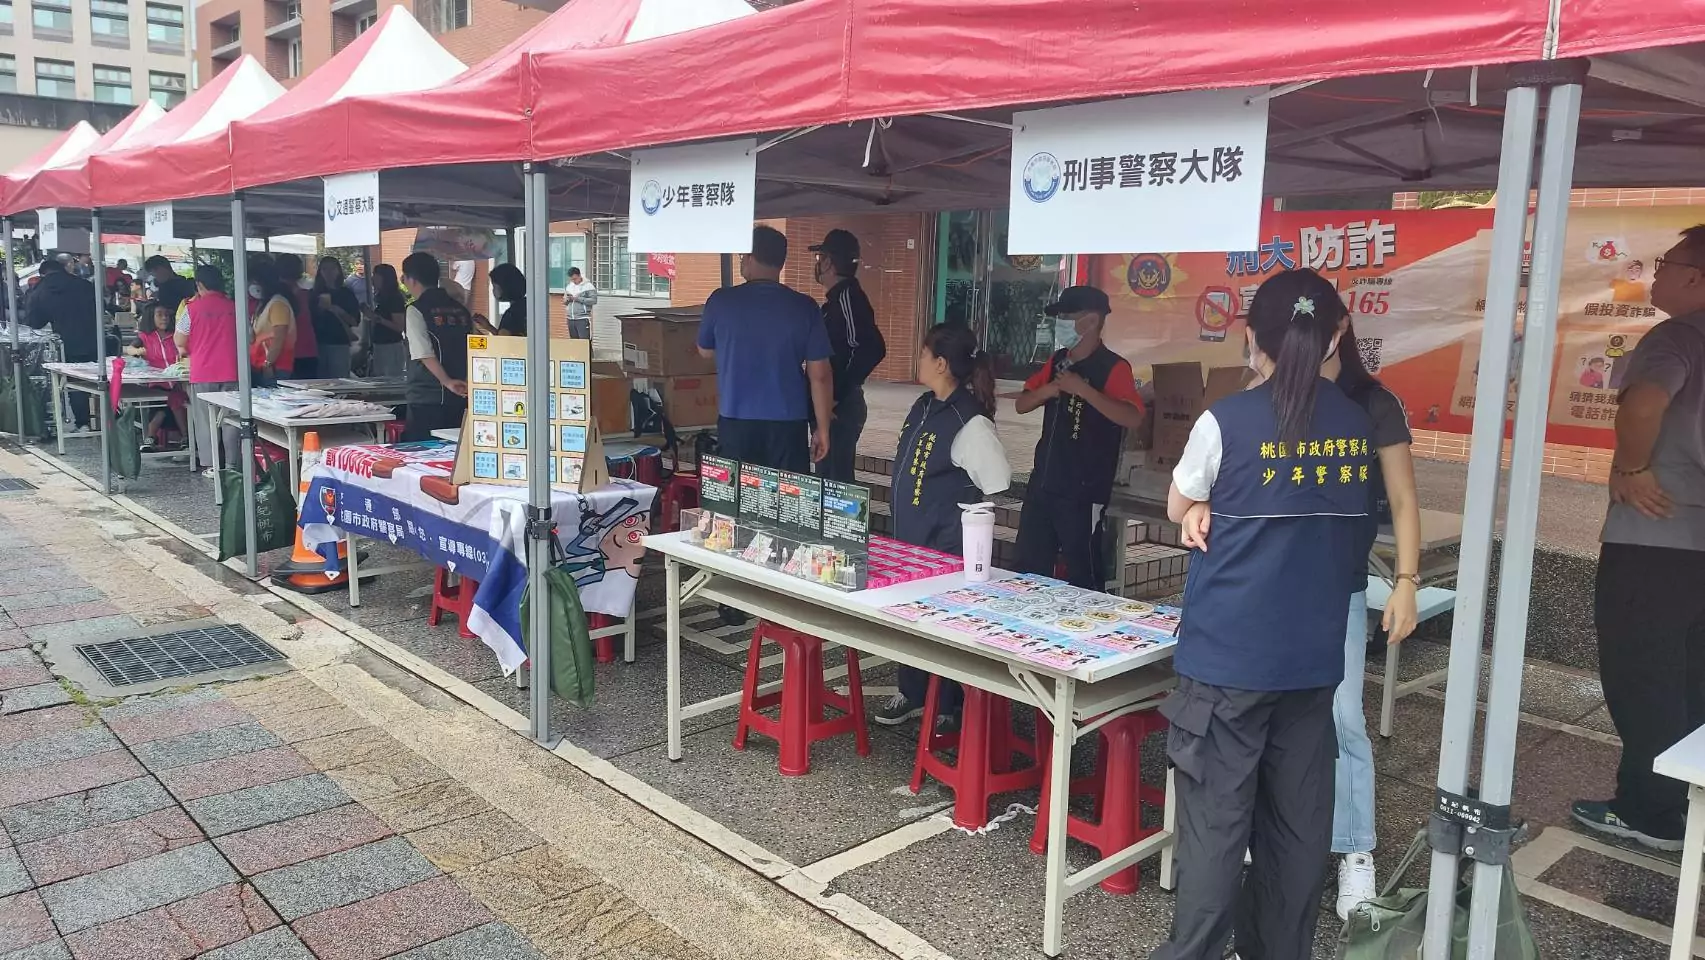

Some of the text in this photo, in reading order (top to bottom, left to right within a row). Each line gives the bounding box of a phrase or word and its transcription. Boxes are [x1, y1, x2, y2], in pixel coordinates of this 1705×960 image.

[1062, 145, 1244, 191] 刑事警察大隊
[662, 181, 735, 208] 少年警察隊
[336, 196, 374, 216] 交通警察大隊
[1348, 291, 1390, 315] 165
[1584, 302, 1656, 318] 假投資詐騙
[1260, 438, 1368, 459] 桃園市政府警察局
[1261, 465, 1368, 486] 少年警察隊
